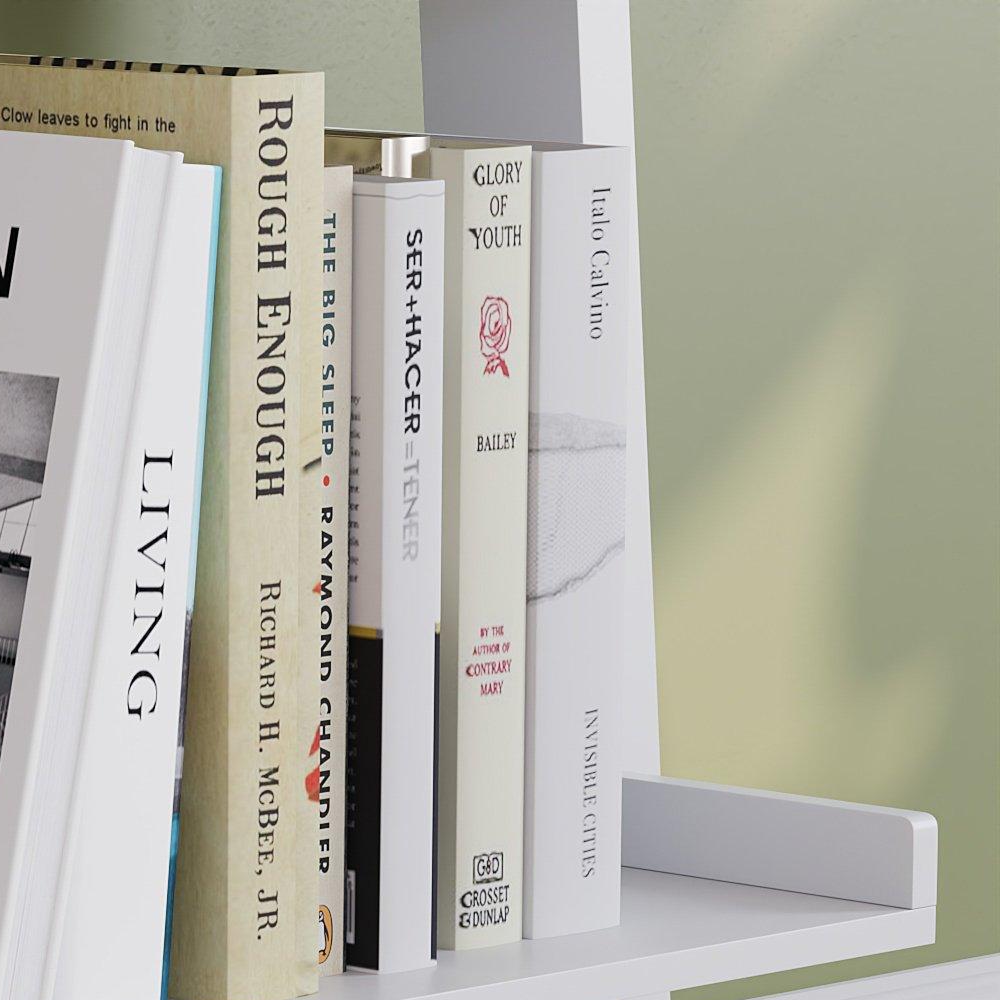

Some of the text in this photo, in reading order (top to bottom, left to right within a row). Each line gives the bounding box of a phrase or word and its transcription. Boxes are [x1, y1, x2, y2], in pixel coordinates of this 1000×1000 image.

[0, 106, 33, 123] Clow
[38, 109, 80, 127] leaves
[85, 112, 98, 128] to
[104, 113, 132, 133] fight
[137, 115, 149, 131] in
[155, 116, 176, 133] the
[473, 161, 523, 187] GLORY
[489, 194, 508, 218] OF
[469, 224, 522, 250] YOUTH
[590, 187, 612, 341] Italo Calvino
[255, 94, 294, 500] ROUGH ENOUGH
[321, 212, 336, 456] THE BIG SLEEP
[476, 432, 517, 453] BAILEY
[126, 449, 174, 721] LIVING
[320, 506, 334, 682] RAYMOND
[480, 625, 504, 638] BY THE
[472, 642, 511, 656] AUTHOR OF
[465, 658, 513, 678] CONTRARY
[480, 680, 504, 697] MARY
[258, 719, 280, 753] H.
[581, 708, 600, 879] INVISIBLE CITIES
[460, 885, 510, 909] GROSSET
[257, 889, 279, 941] JR.
[472, 905, 510, 928] DUNLAP
